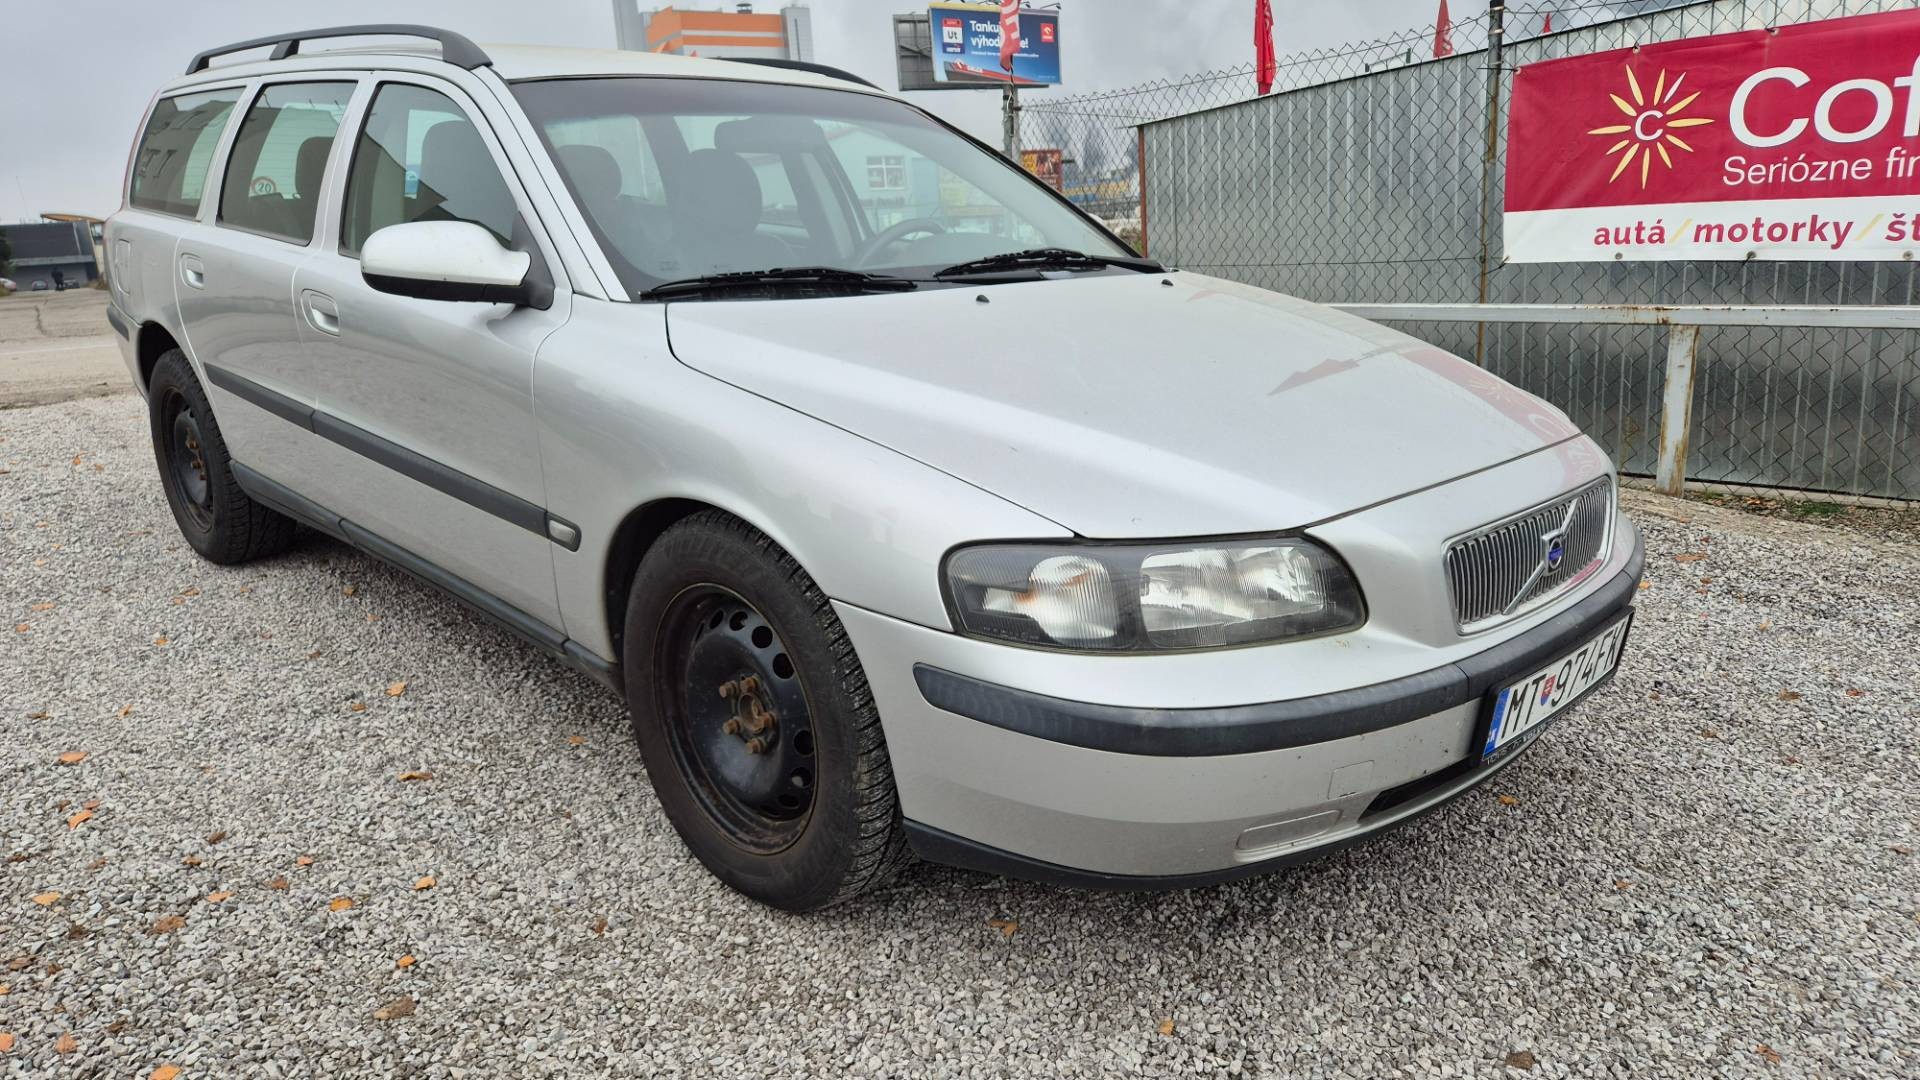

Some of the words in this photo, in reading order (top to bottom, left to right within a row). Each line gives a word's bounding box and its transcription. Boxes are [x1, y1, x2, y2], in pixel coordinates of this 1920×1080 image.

[1729, 54, 1920, 148] Cof
[1635, 110, 1664, 140] C
[1723, 153, 1872, 186] Seriózne
[257, 183, 272, 193] 20
[1594, 219, 1666, 245] autá
[1693, 214, 1854, 250] motorky
[1501, 673, 1547, 739] MT
